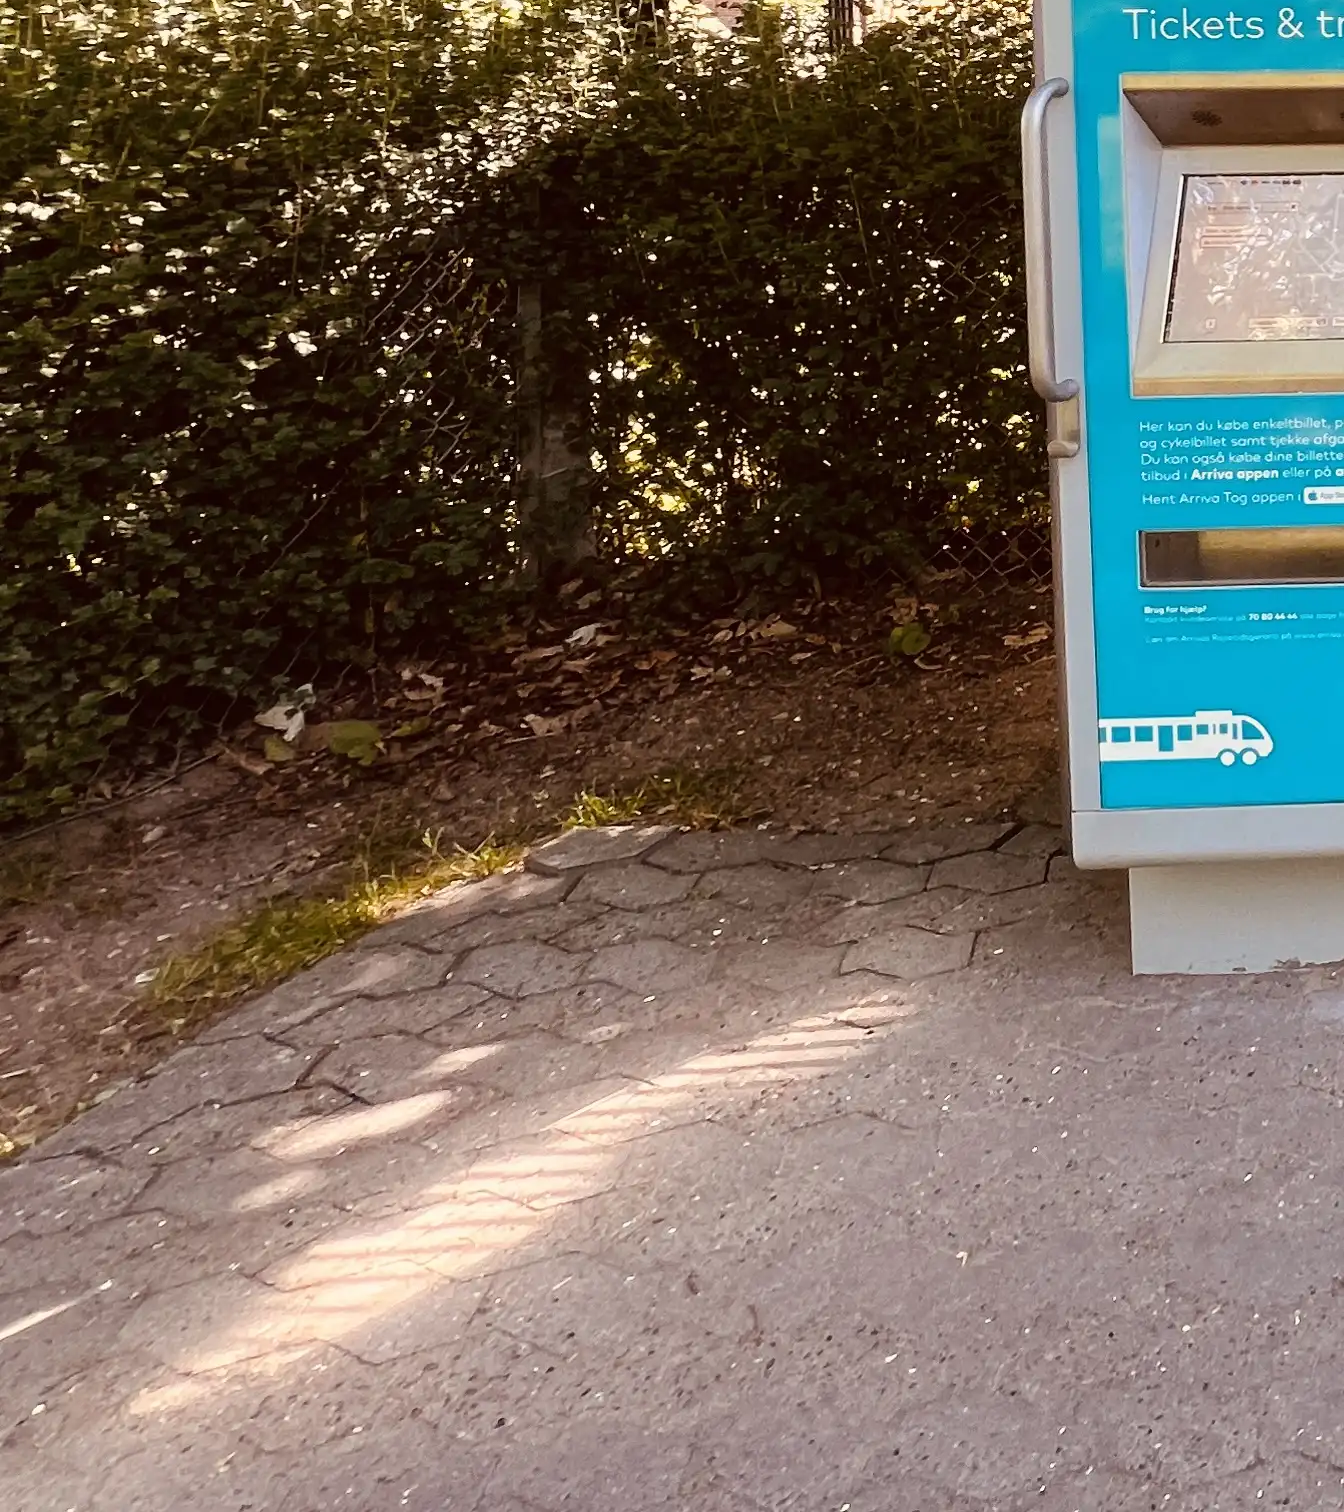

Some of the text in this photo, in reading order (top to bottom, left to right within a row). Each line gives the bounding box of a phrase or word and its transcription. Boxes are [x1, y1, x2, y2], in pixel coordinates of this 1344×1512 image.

[1122, 7, 1266, 41] Tickets
[1276, 7, 1304, 38] &
[1139, 421, 1164, 433] Her
[1167, 421, 1192, 432] kan
[1195, 420, 1213, 431] du
[1217, 419, 1249, 431] købe
[1139, 439, 1157, 451] og
[1160, 436, 1227, 450] cykelbillet
[1230, 436, 1266, 448] samt
[1269, 435, 1310, 448] tjekke
[1140, 453, 1160, 466] Du
[1163, 453, 1188, 465] kan
[1191, 451, 1225, 466] også
[1228, 451, 1261, 464] købe
[1264, 451, 1293, 463] dine
[1140, 469, 1181, 481] tilbud
[1190, 468, 1234, 480] Arriva
[1236, 469, 1280, 482] appen
[1282, 467, 1310, 478] eller
[1314, 465, 1332, 479] på
[1142, 493, 1176, 505] Hent
[1179, 493, 1220, 504] Arriva
[1223, 491, 1248, 506] Tog
[1251, 492, 1294, 505] appen
[1143, 606, 1165, 615] Brug
[1165, 605, 1179, 613] for
